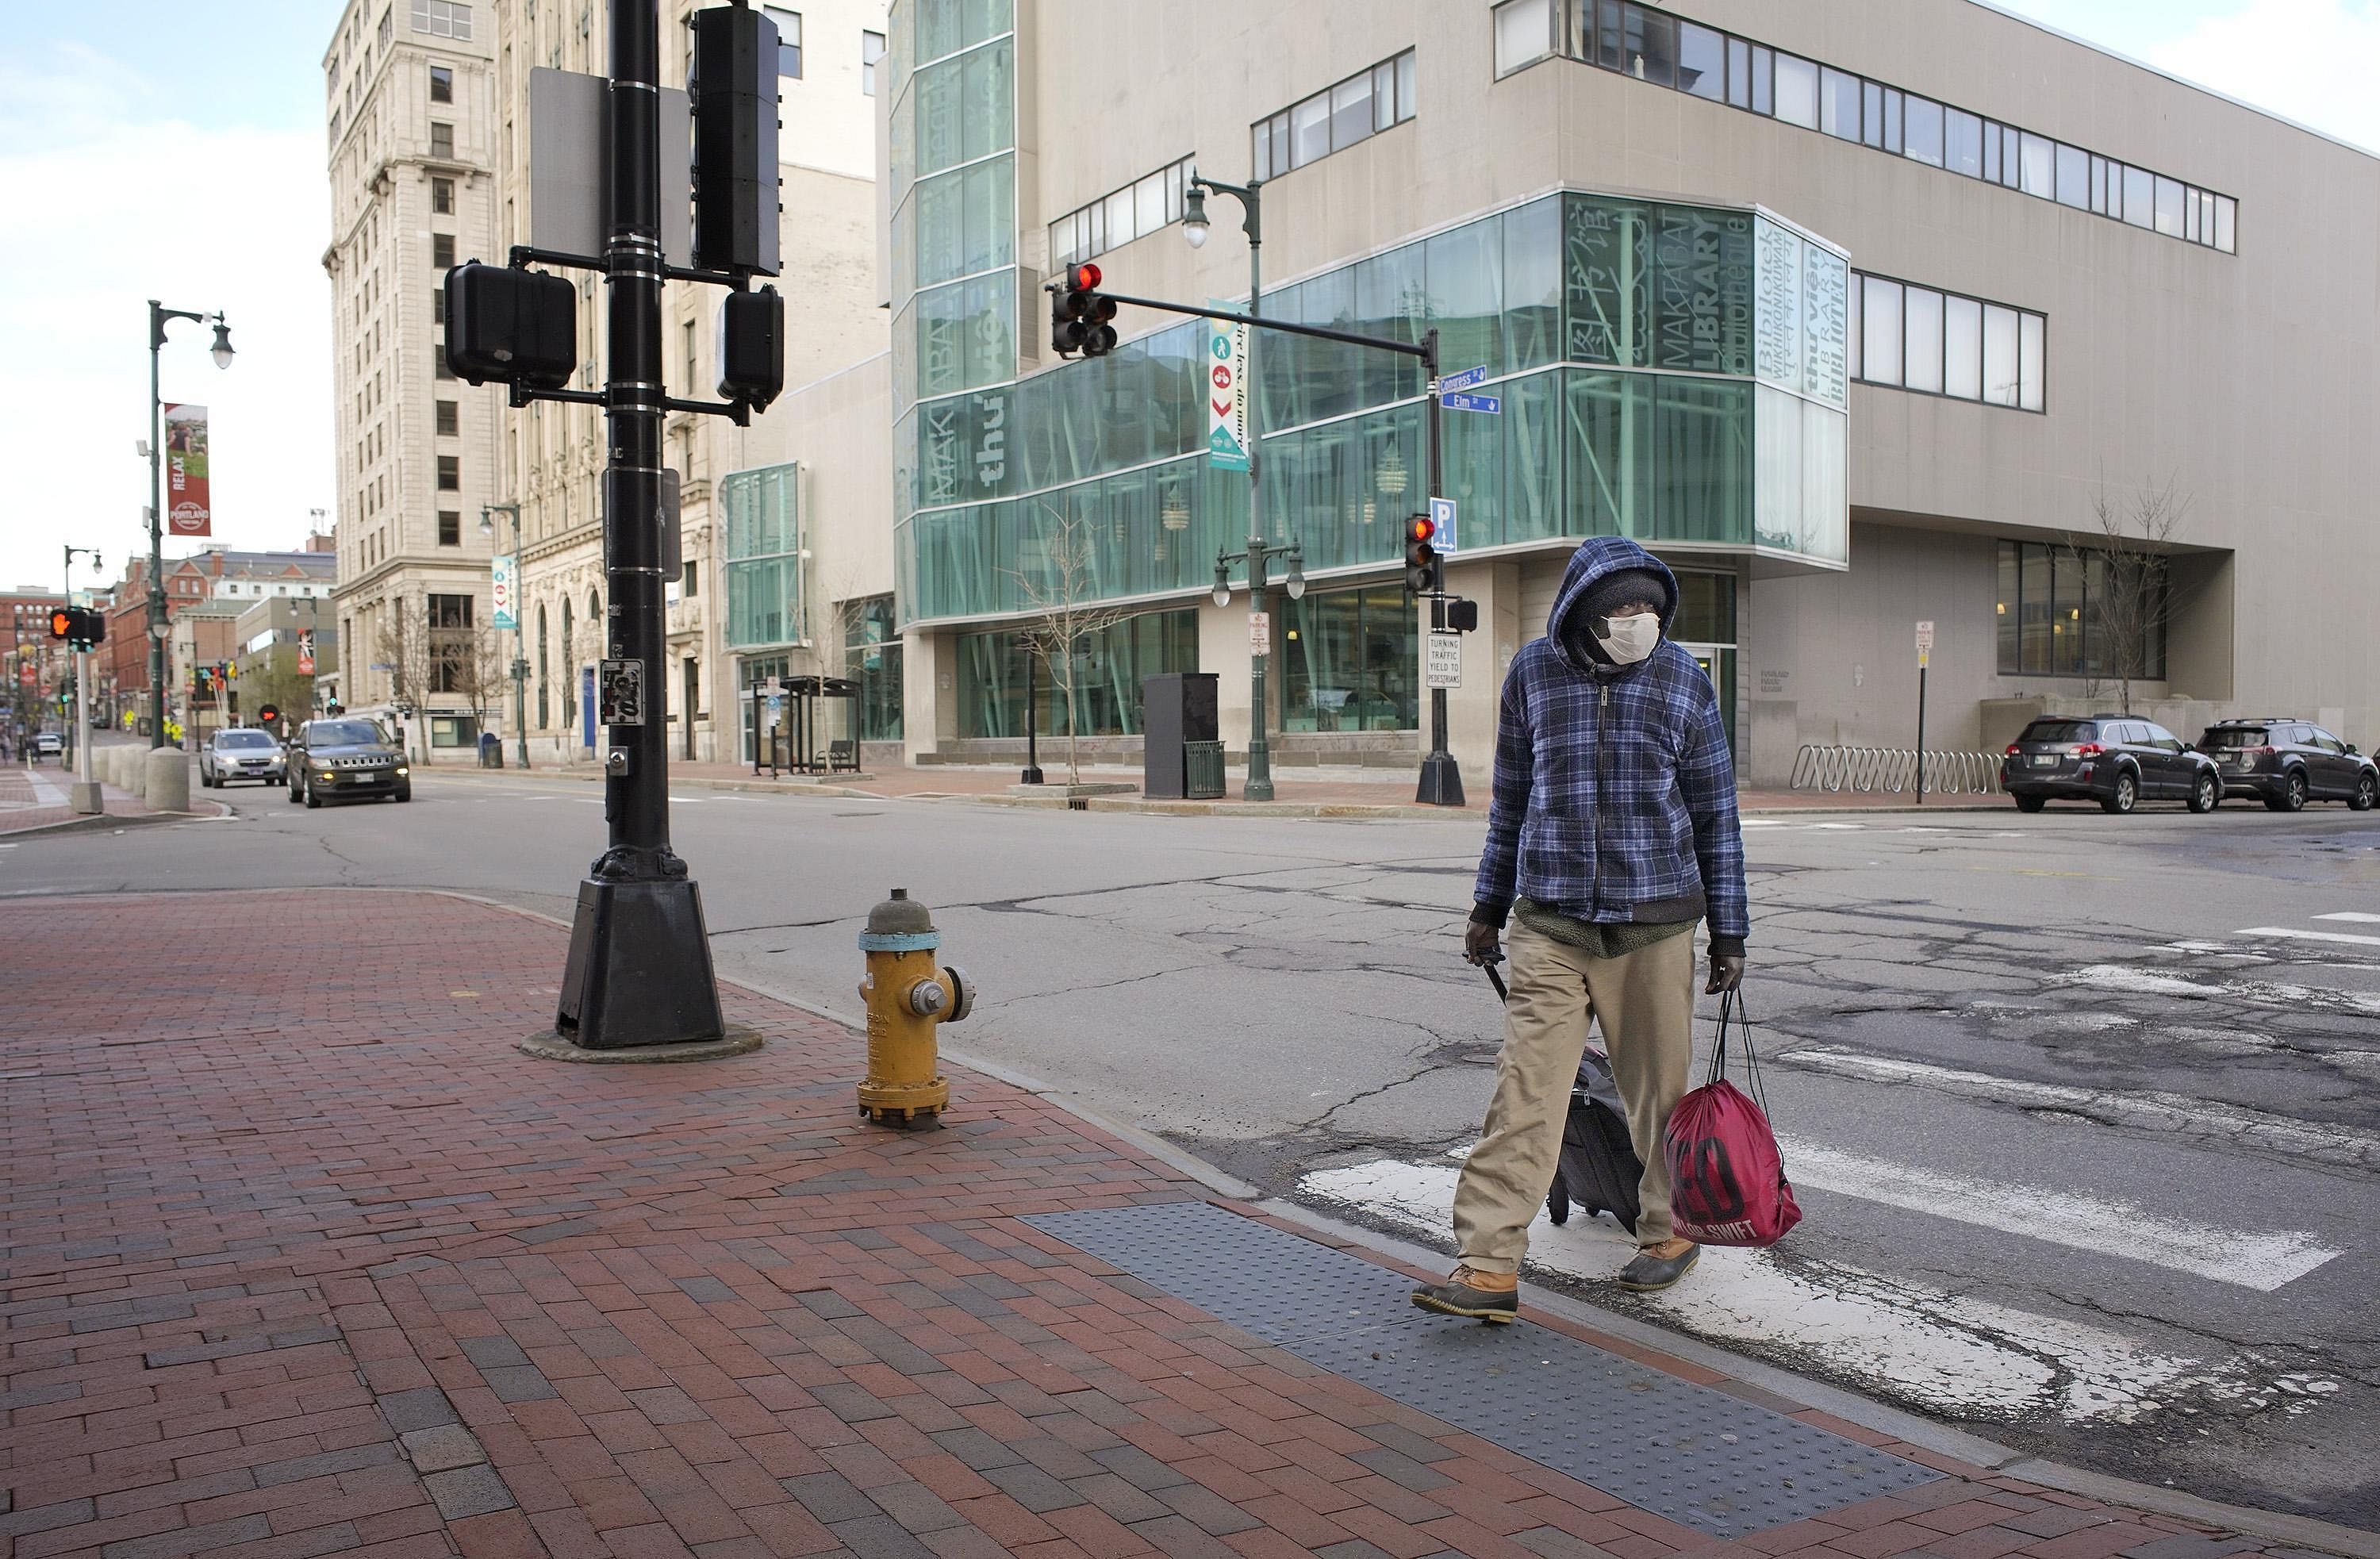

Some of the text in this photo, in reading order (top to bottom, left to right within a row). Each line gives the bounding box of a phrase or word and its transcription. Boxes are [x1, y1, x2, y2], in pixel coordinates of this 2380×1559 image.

[1568, 202, 1614, 362] 图书馆
[1662, 208, 1690, 367] MAKTABAT
[1693, 211, 1720, 371] LIBRARY
[1773, 230, 1783, 379] WIKHIKONIKUWAM
[1821, 252, 1829, 398] LIBRARY
[1830, 263, 1844, 402] BIBLIOTECA
[1440, 374, 1472, 392] Congress
[1453, 394, 1470, 408] Elm
[172, 456, 186, 491] RELAX
[1438, 503, 1451, 528] P
[1430, 639, 1459, 649] TURNING
[1432, 651, 1457, 660] TRAFFIC
[1428, 674, 1460, 684] PEDESTRIANS
[1430, 662, 1459, 673] YIELD TO
[1706, 1219, 1757, 1240] SWIFT
